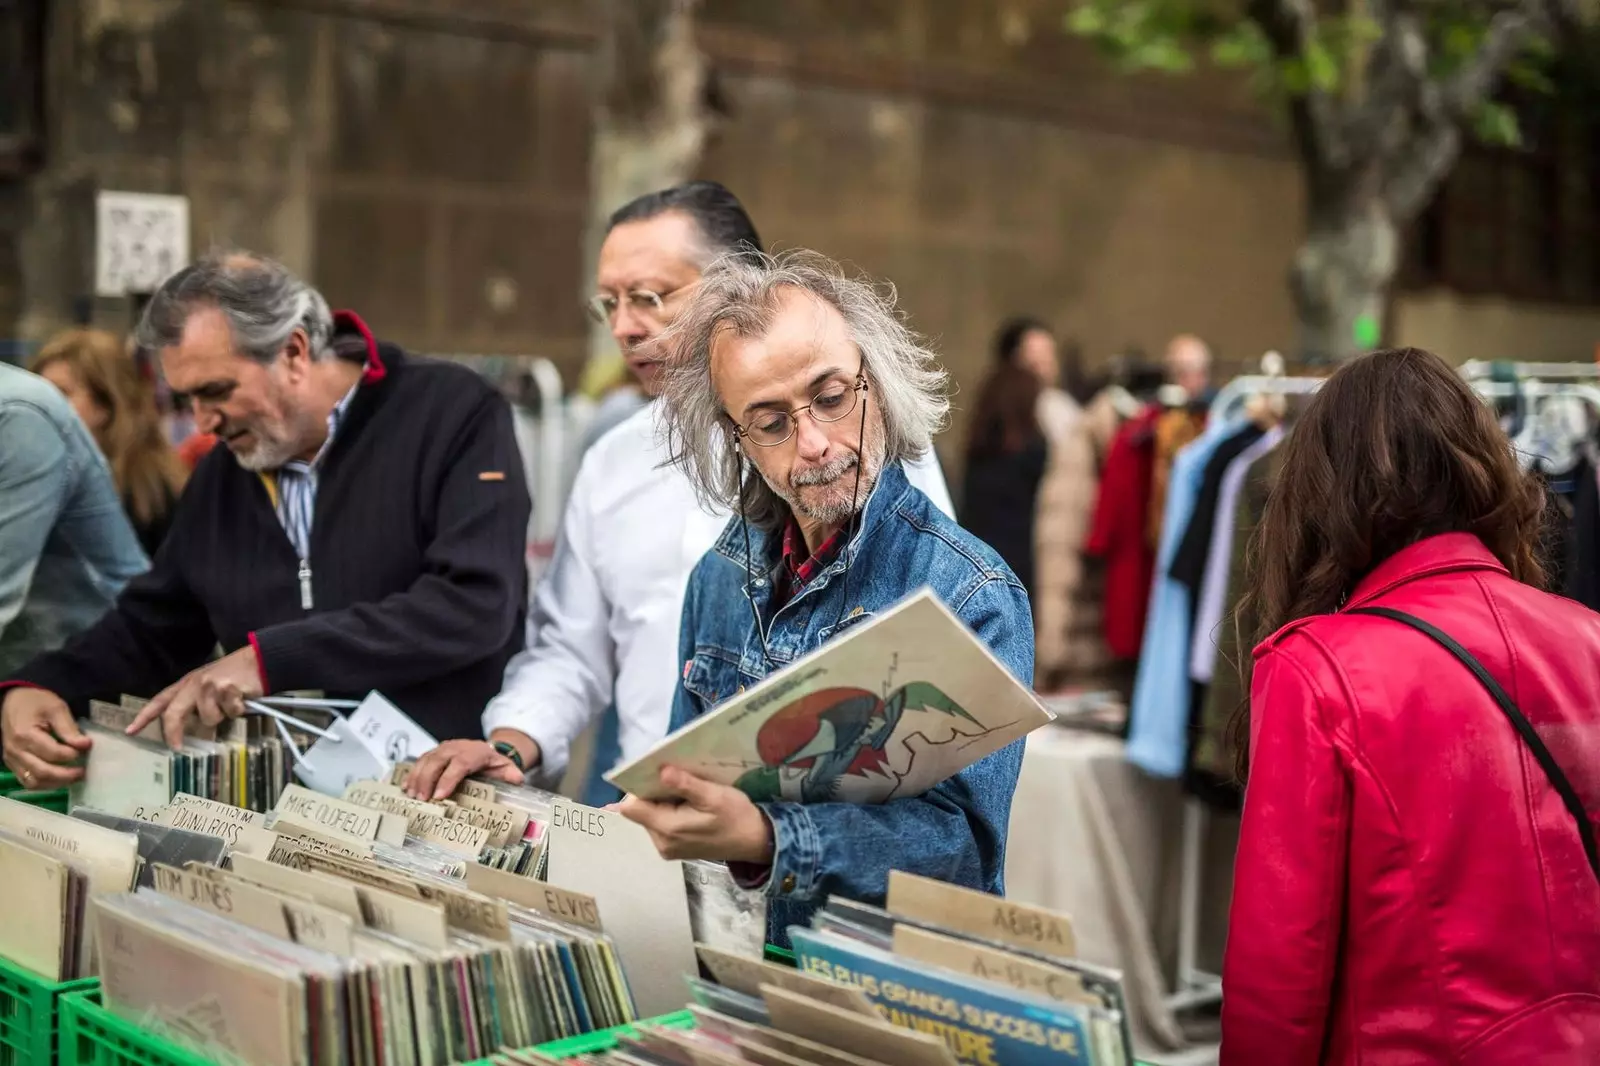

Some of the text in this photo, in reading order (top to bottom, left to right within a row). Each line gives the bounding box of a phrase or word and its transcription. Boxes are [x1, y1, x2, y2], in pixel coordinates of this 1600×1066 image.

[172, 807, 244, 846] DIANA ROSS
[284, 794, 316, 819] MIKE
[314, 804, 371, 837] OLDFIELD
[410, 813, 484, 847] MORRISON
[553, 805, 605, 837] EAGLES
[156, 866, 183, 895] TOM
[190, 877, 233, 912] JONES
[544, 889, 597, 924] ELVIS
[801, 954, 834, 983] LES
[880, 980, 961, 1021] GRANDS
[1047, 1027, 1079, 1056] DE
